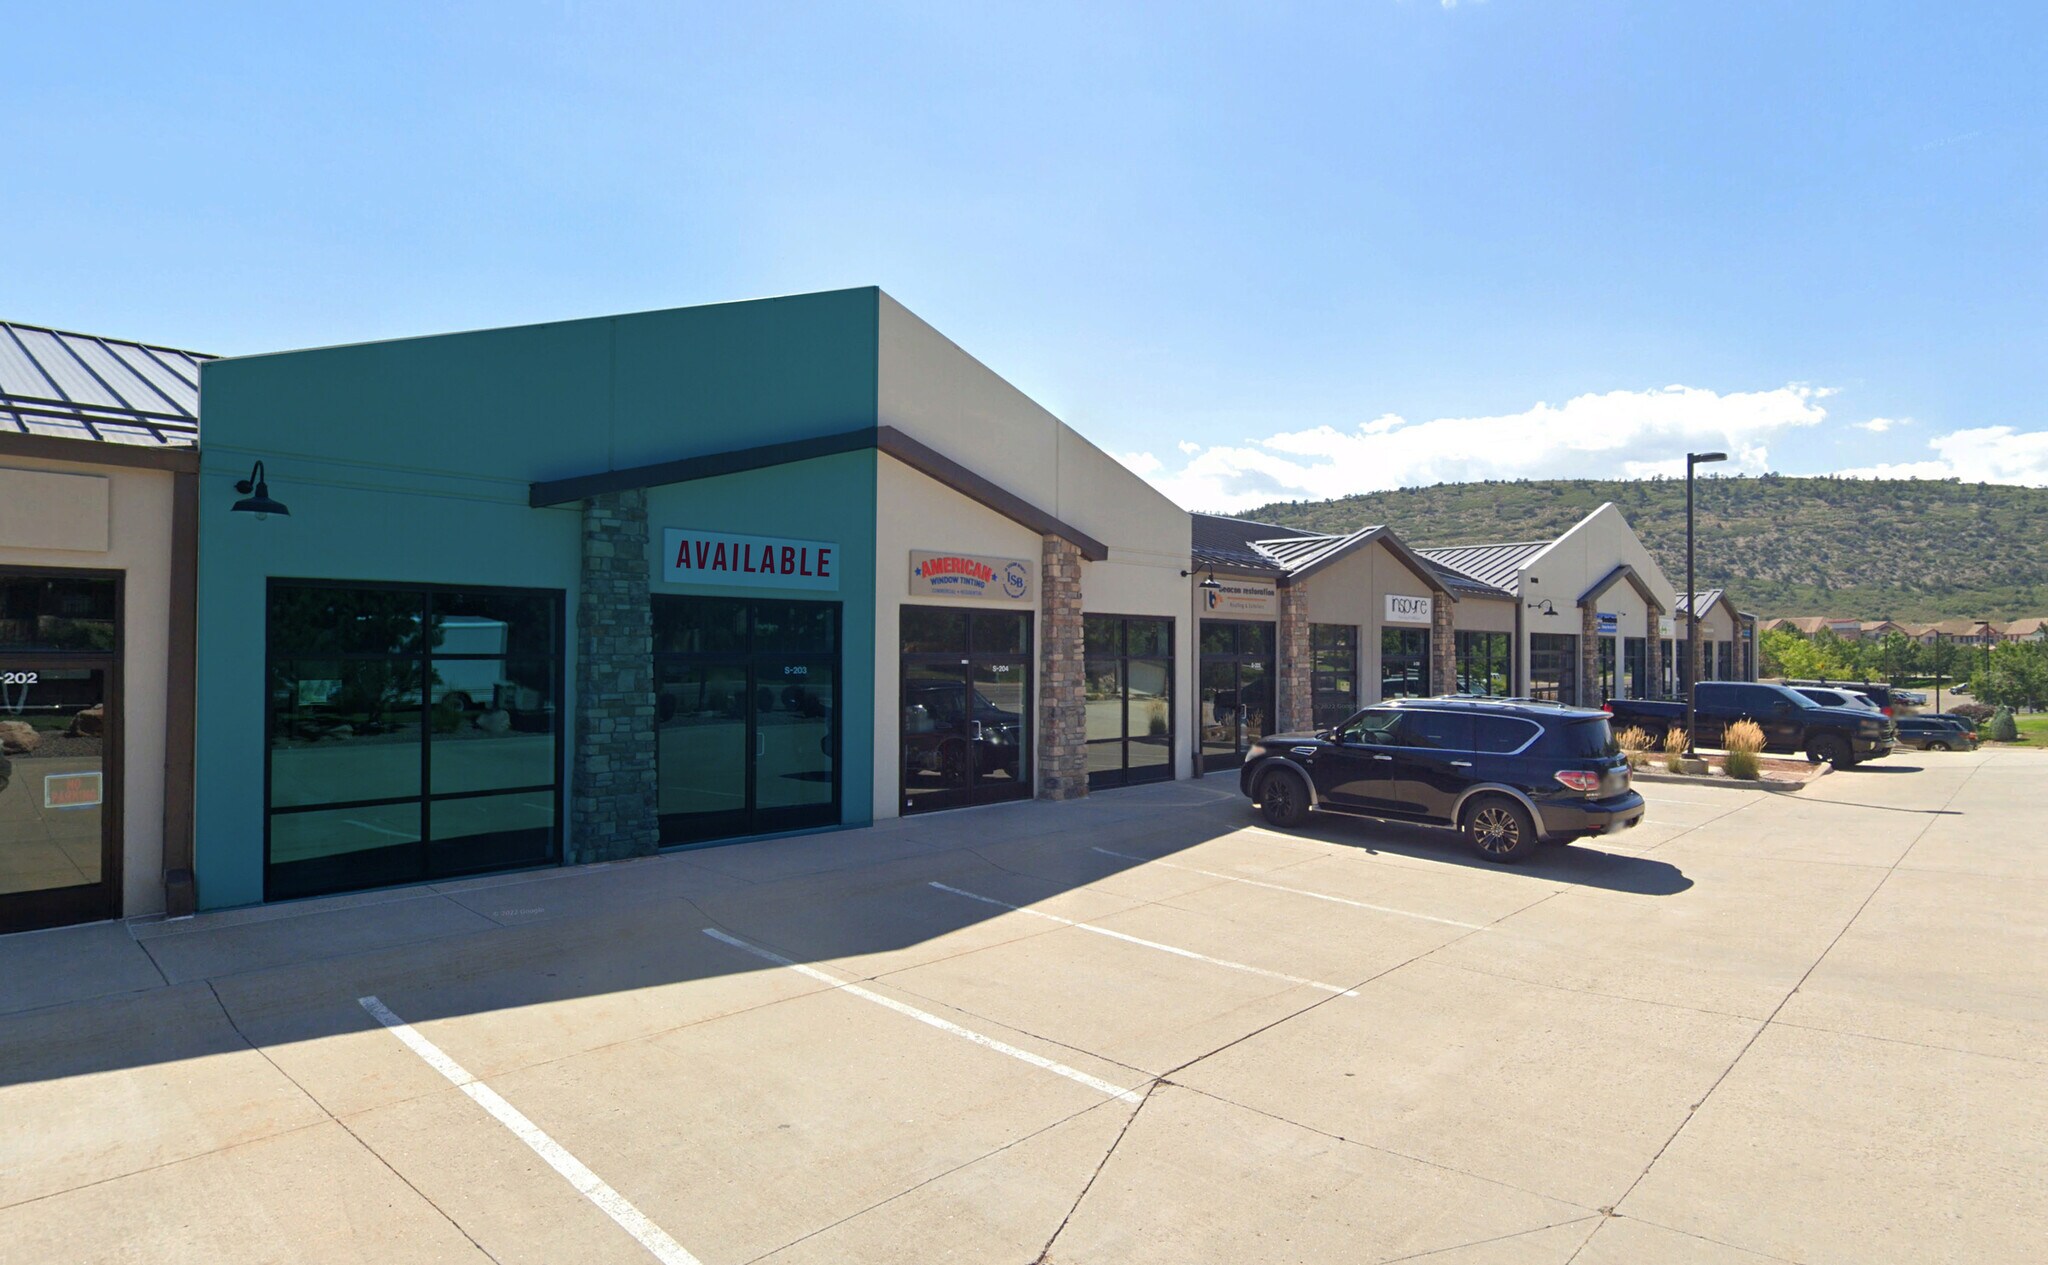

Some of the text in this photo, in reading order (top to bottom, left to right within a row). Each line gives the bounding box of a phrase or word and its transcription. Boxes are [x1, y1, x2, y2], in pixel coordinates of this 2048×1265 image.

[676, 540, 831, 577] AVAILABLE
[922, 557, 993, 582] AMERICAN
[930, 576, 985, 588] WINDOW TINTING
[1007, 572, 1024, 588] ISB
[1242, 587, 1275, 596] restoration
[784, 666, 808, 675] S-203
[992, 665, 1009, 673] S-204
